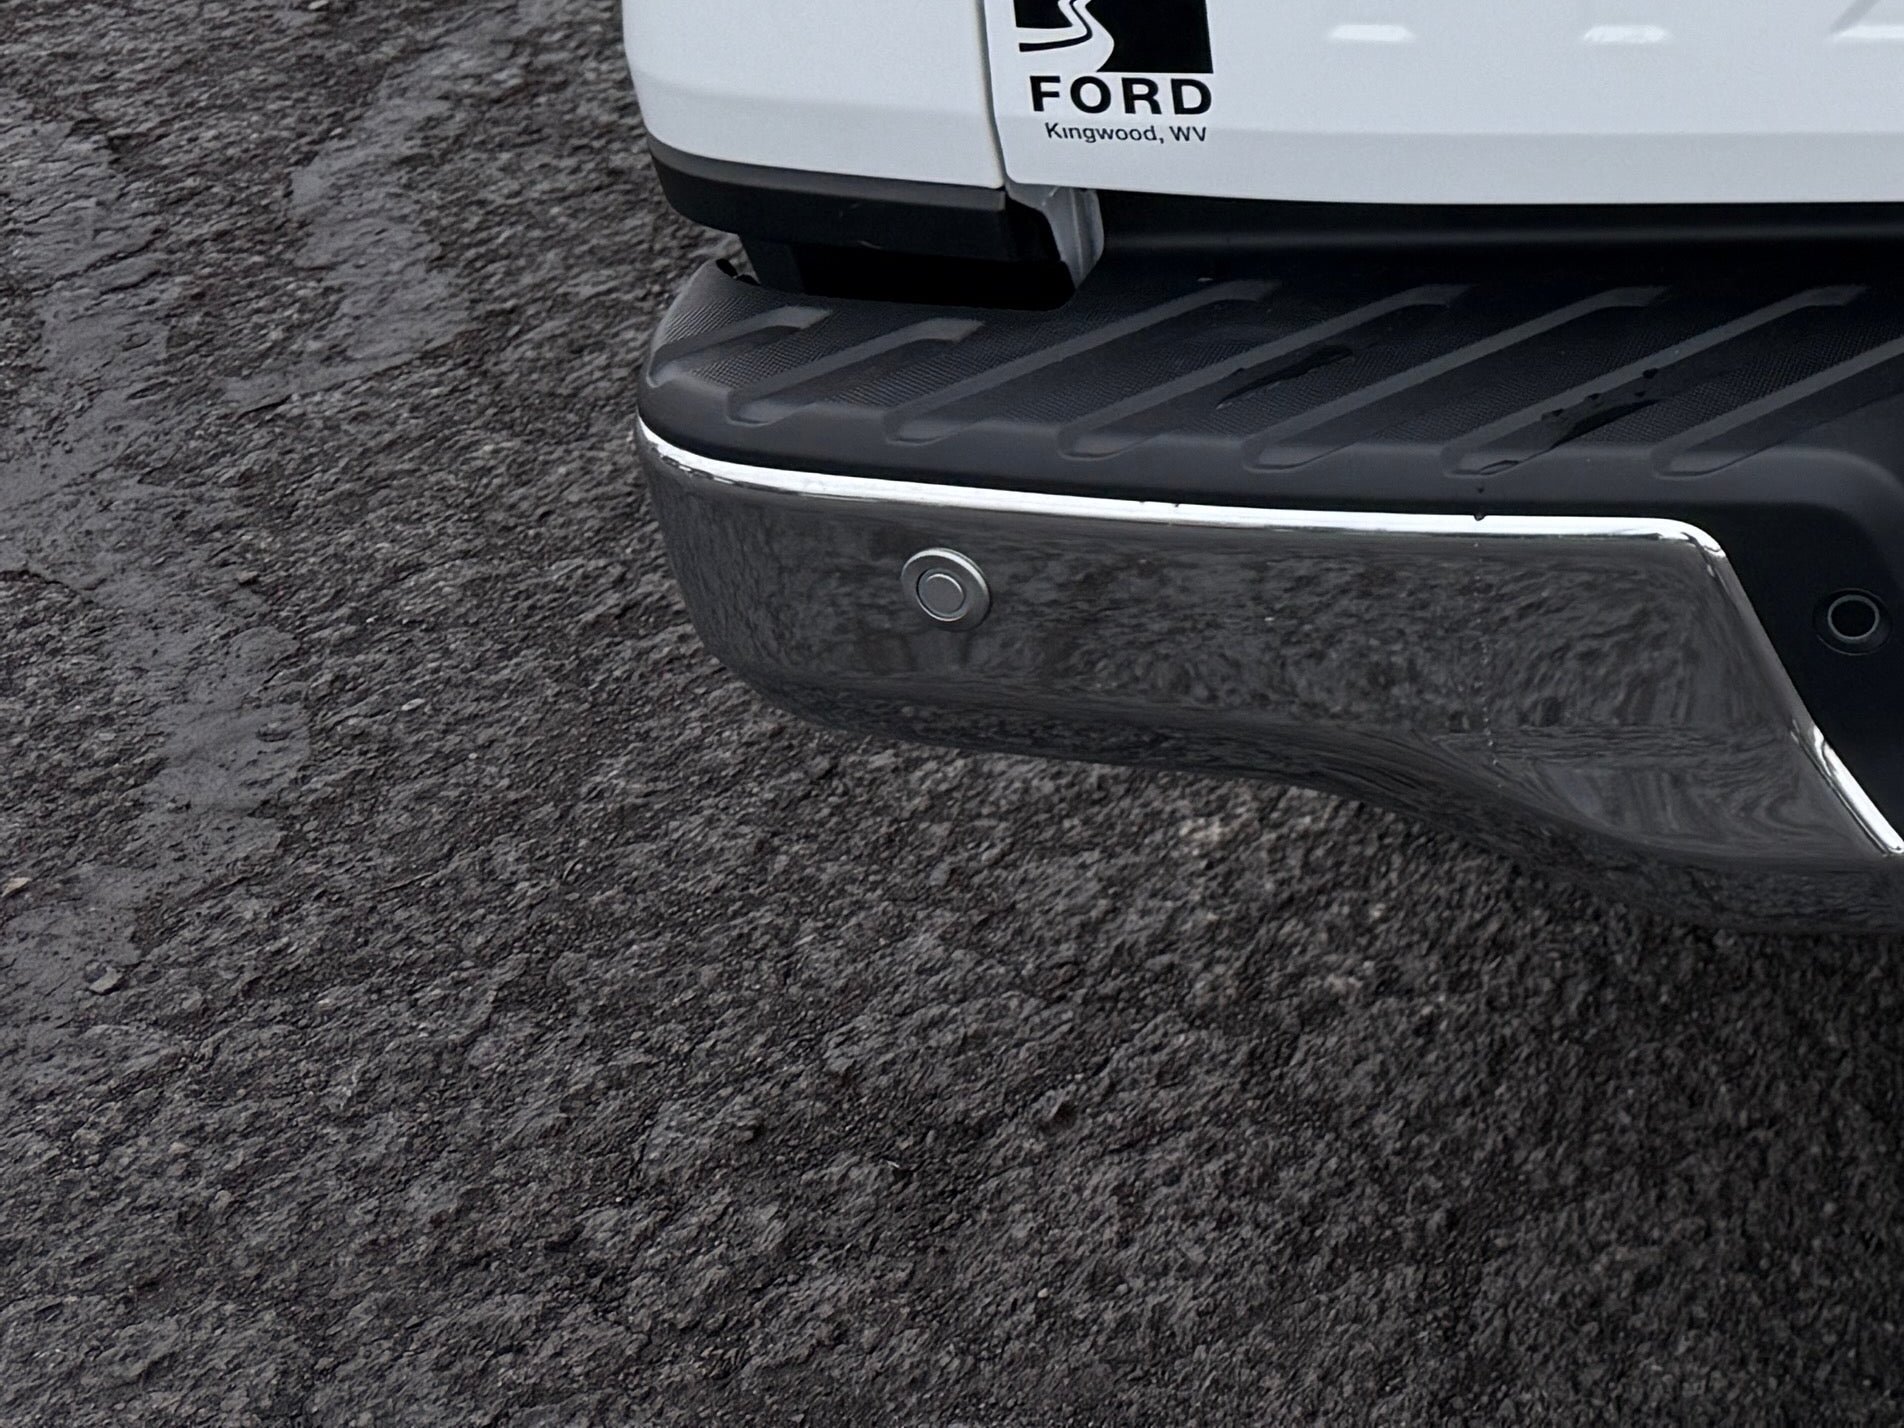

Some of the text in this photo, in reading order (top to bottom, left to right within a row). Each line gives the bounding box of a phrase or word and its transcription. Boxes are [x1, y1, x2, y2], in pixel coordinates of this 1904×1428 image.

[1029, 75, 1212, 115] FORD
[1044, 121, 1207, 145] Kingwood, WV
